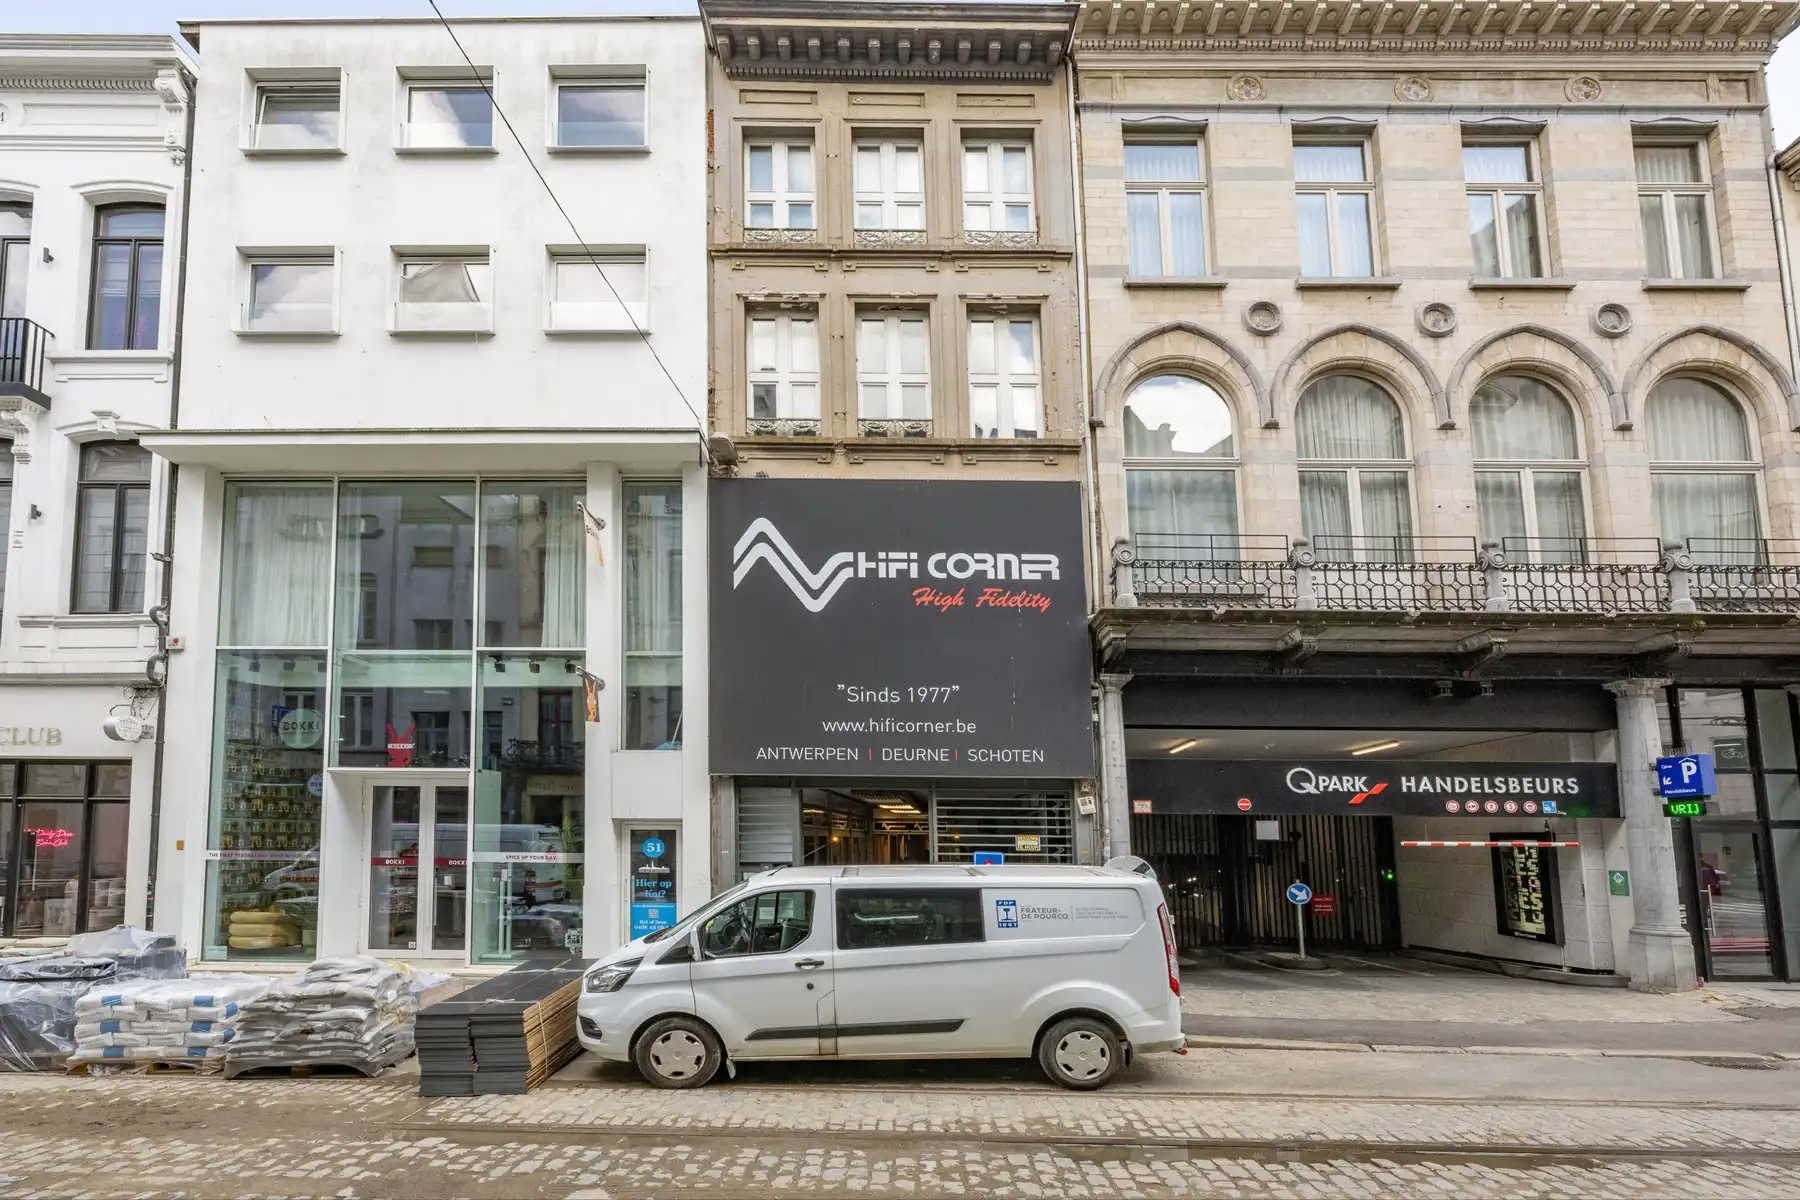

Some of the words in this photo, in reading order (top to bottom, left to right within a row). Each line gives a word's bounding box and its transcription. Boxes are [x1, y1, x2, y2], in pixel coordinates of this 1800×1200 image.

[928, 553, 1060, 580] CORNER
[912, 587, 965, 612] High
[975, 587, 1051, 612] Fidelity
[283, 721, 320, 731] BOKKI
[822, 718, 977, 734] www.hificorner.be
[0, 727, 62, 746] CLUB
[756, 747, 859, 761] ANTWERPEN
[882, 748, 950, 762] DEURNE
[967, 749, 1044, 763] SCHOTEN
[1681, 761, 1697, 784] P
[1401, 776, 1579, 795] HANDELSBEURS
[1670, 803, 1700, 815] VRIJ
[646, 843, 662, 853] 51
[635, 879, 657, 888] Hier
[659, 880, 672, 888] op
